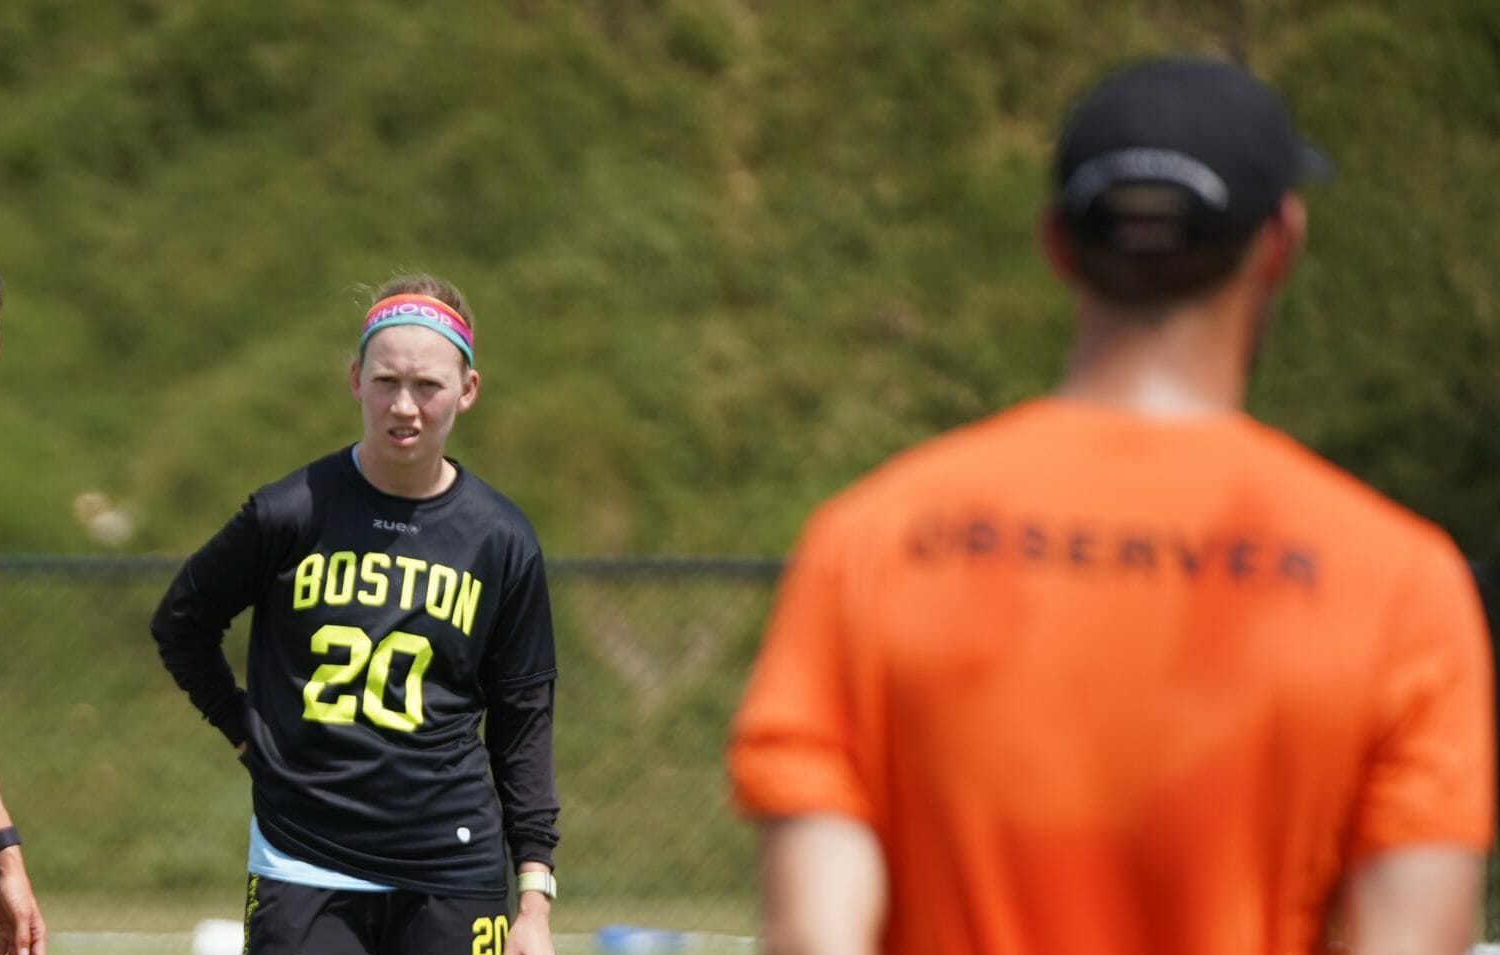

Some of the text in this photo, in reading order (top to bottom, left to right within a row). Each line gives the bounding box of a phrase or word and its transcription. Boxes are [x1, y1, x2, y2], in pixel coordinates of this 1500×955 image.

[369, 303, 454, 326] WHOOP
[293, 551, 482, 637] BOSTON
[905, 508, 1320, 594] OBSERVER
[302, 624, 434, 733] 20
